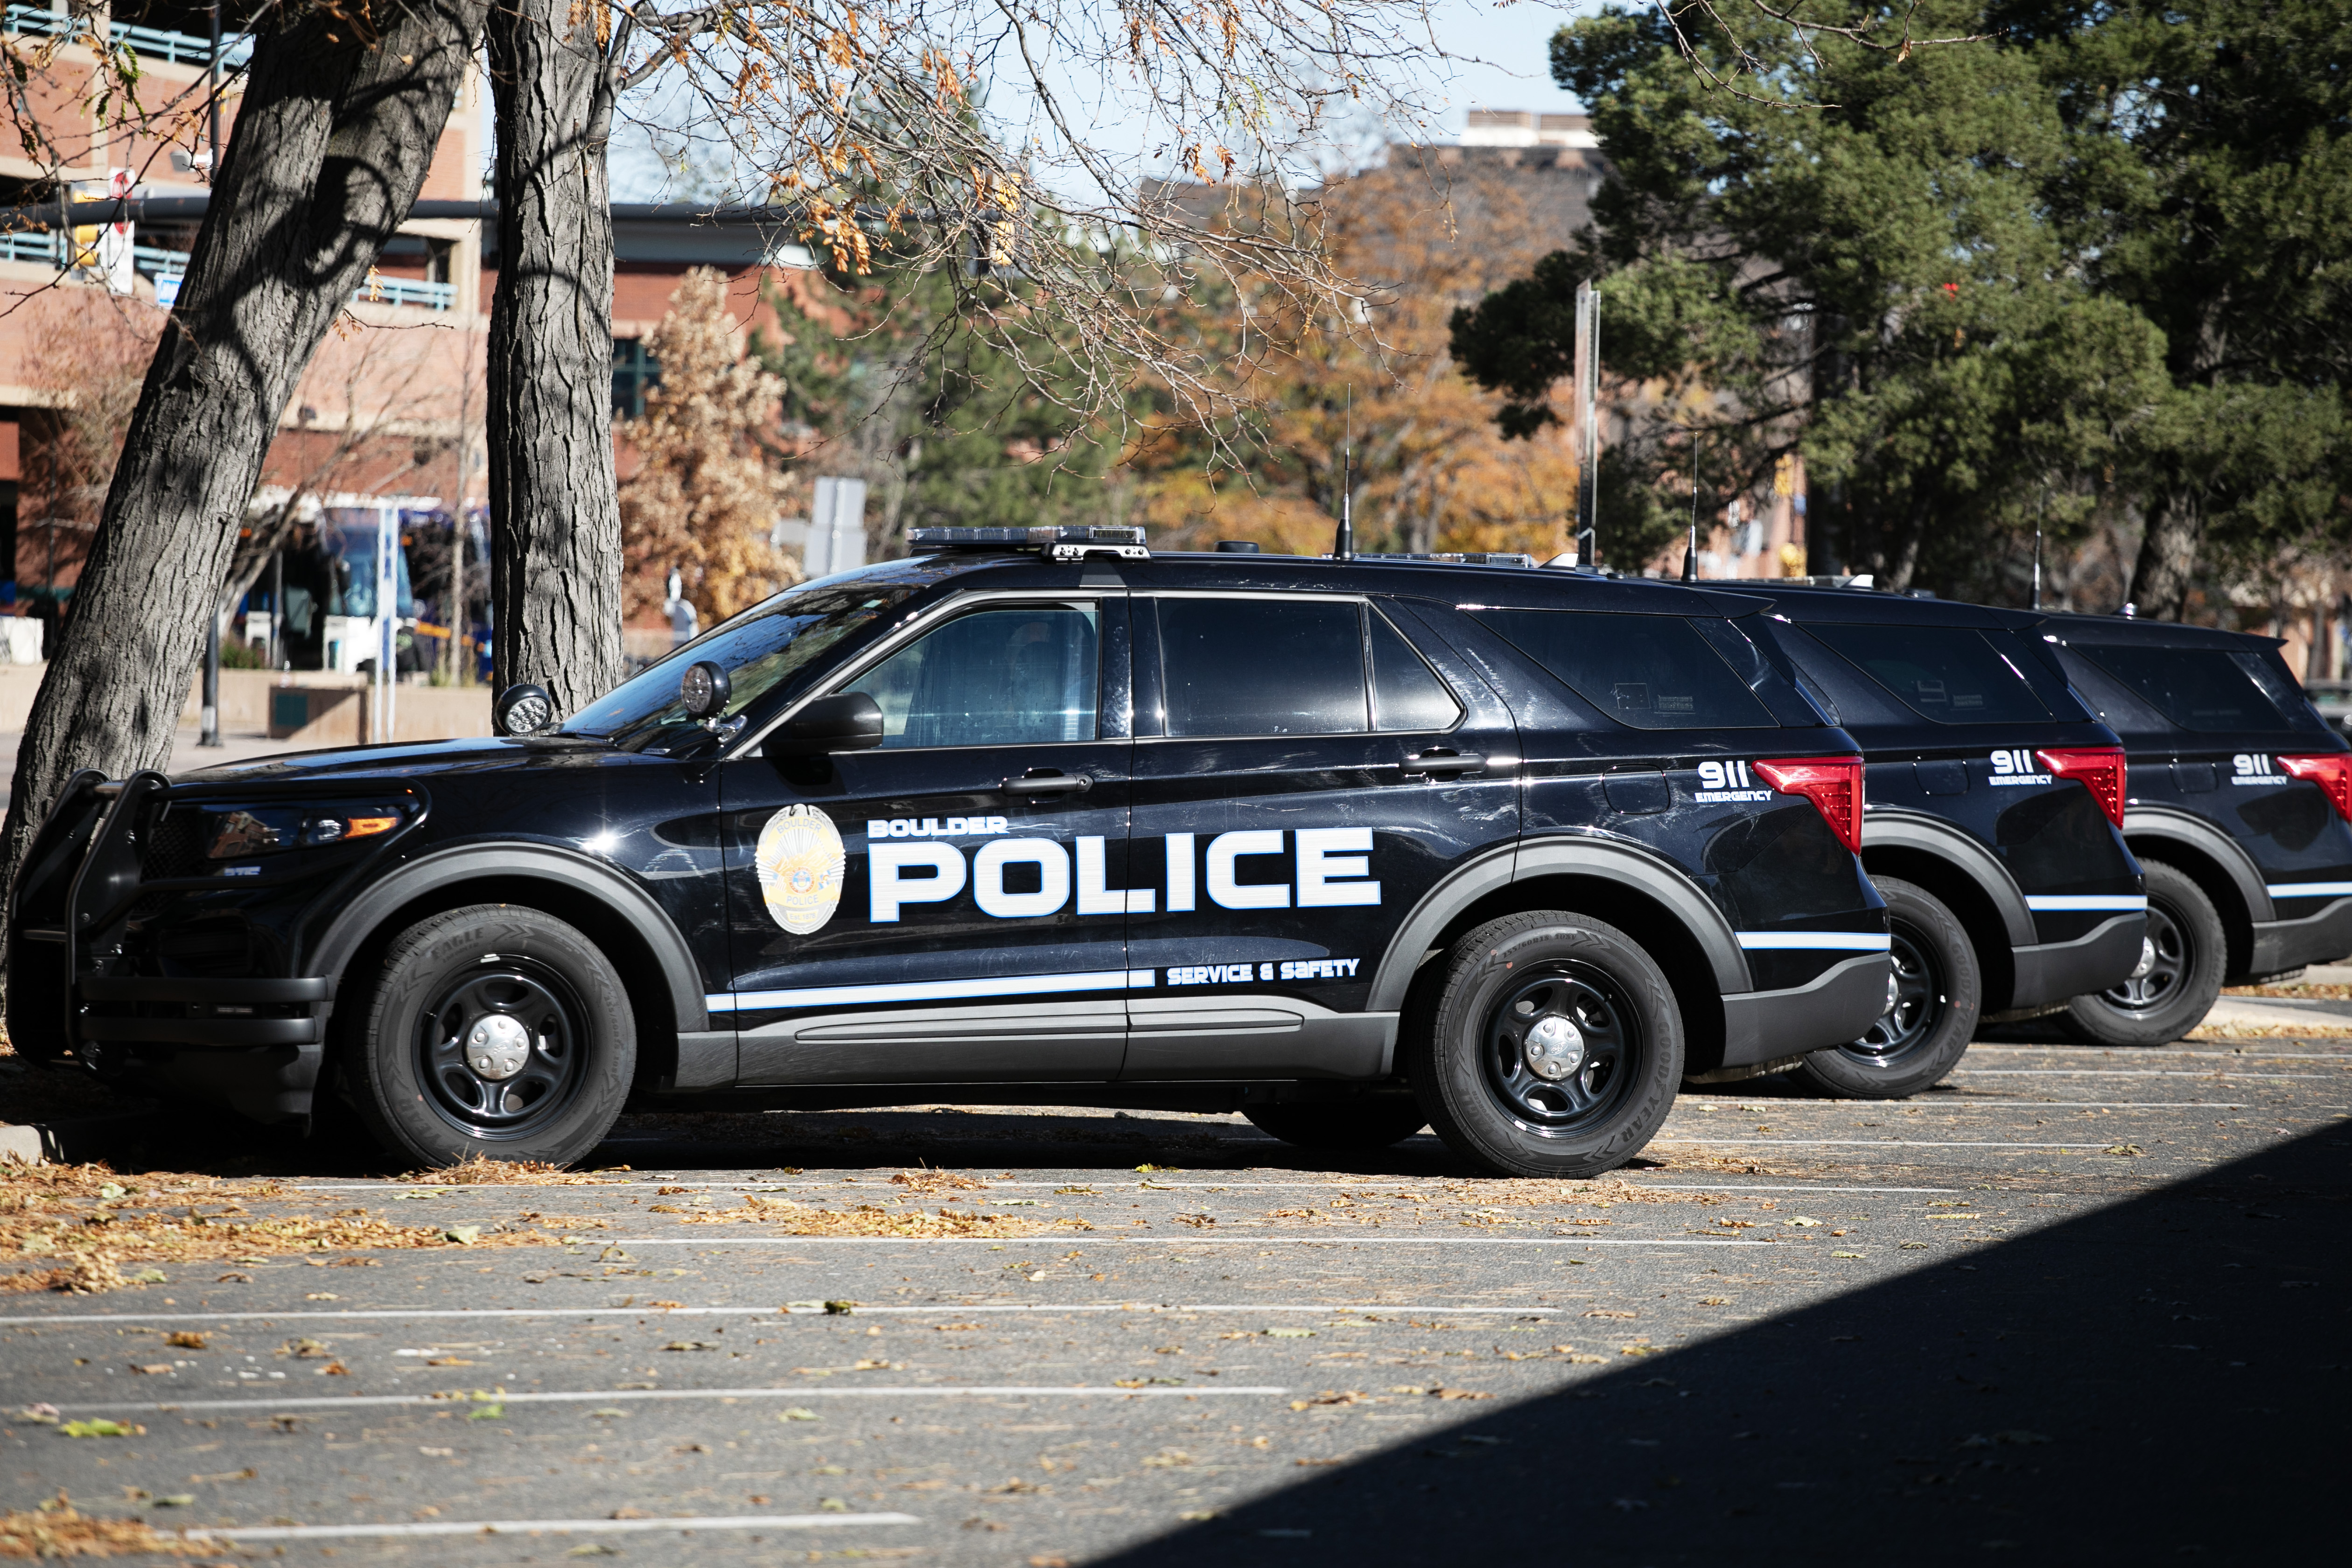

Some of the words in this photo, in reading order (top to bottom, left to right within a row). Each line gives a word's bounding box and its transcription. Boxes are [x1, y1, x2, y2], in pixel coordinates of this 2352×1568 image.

[1990, 749, 2034, 774] 911
[2233, 754, 2272, 775] 911
[1697, 760, 1750, 789] 911
[1988, 775, 2052, 786] EMERGENCY
[2231, 775, 2287, 786] EMERGENCY
[1694, 790, 1772, 803] EMERGENCY
[777, 818, 822, 834] BOULDER
[868, 816, 1010, 839] BOULDER
[868, 826, 1381, 923] POLICE
[786, 894, 819, 906] POLICE
[430, 927, 484, 960] EAGLE
[1167, 964, 1253, 986] SERVICE
[1260, 963, 1274, 980] &
[1456, 1088, 1496, 1136] EAGLE
[1471, 1090, 1496, 1124] ENFORCER
